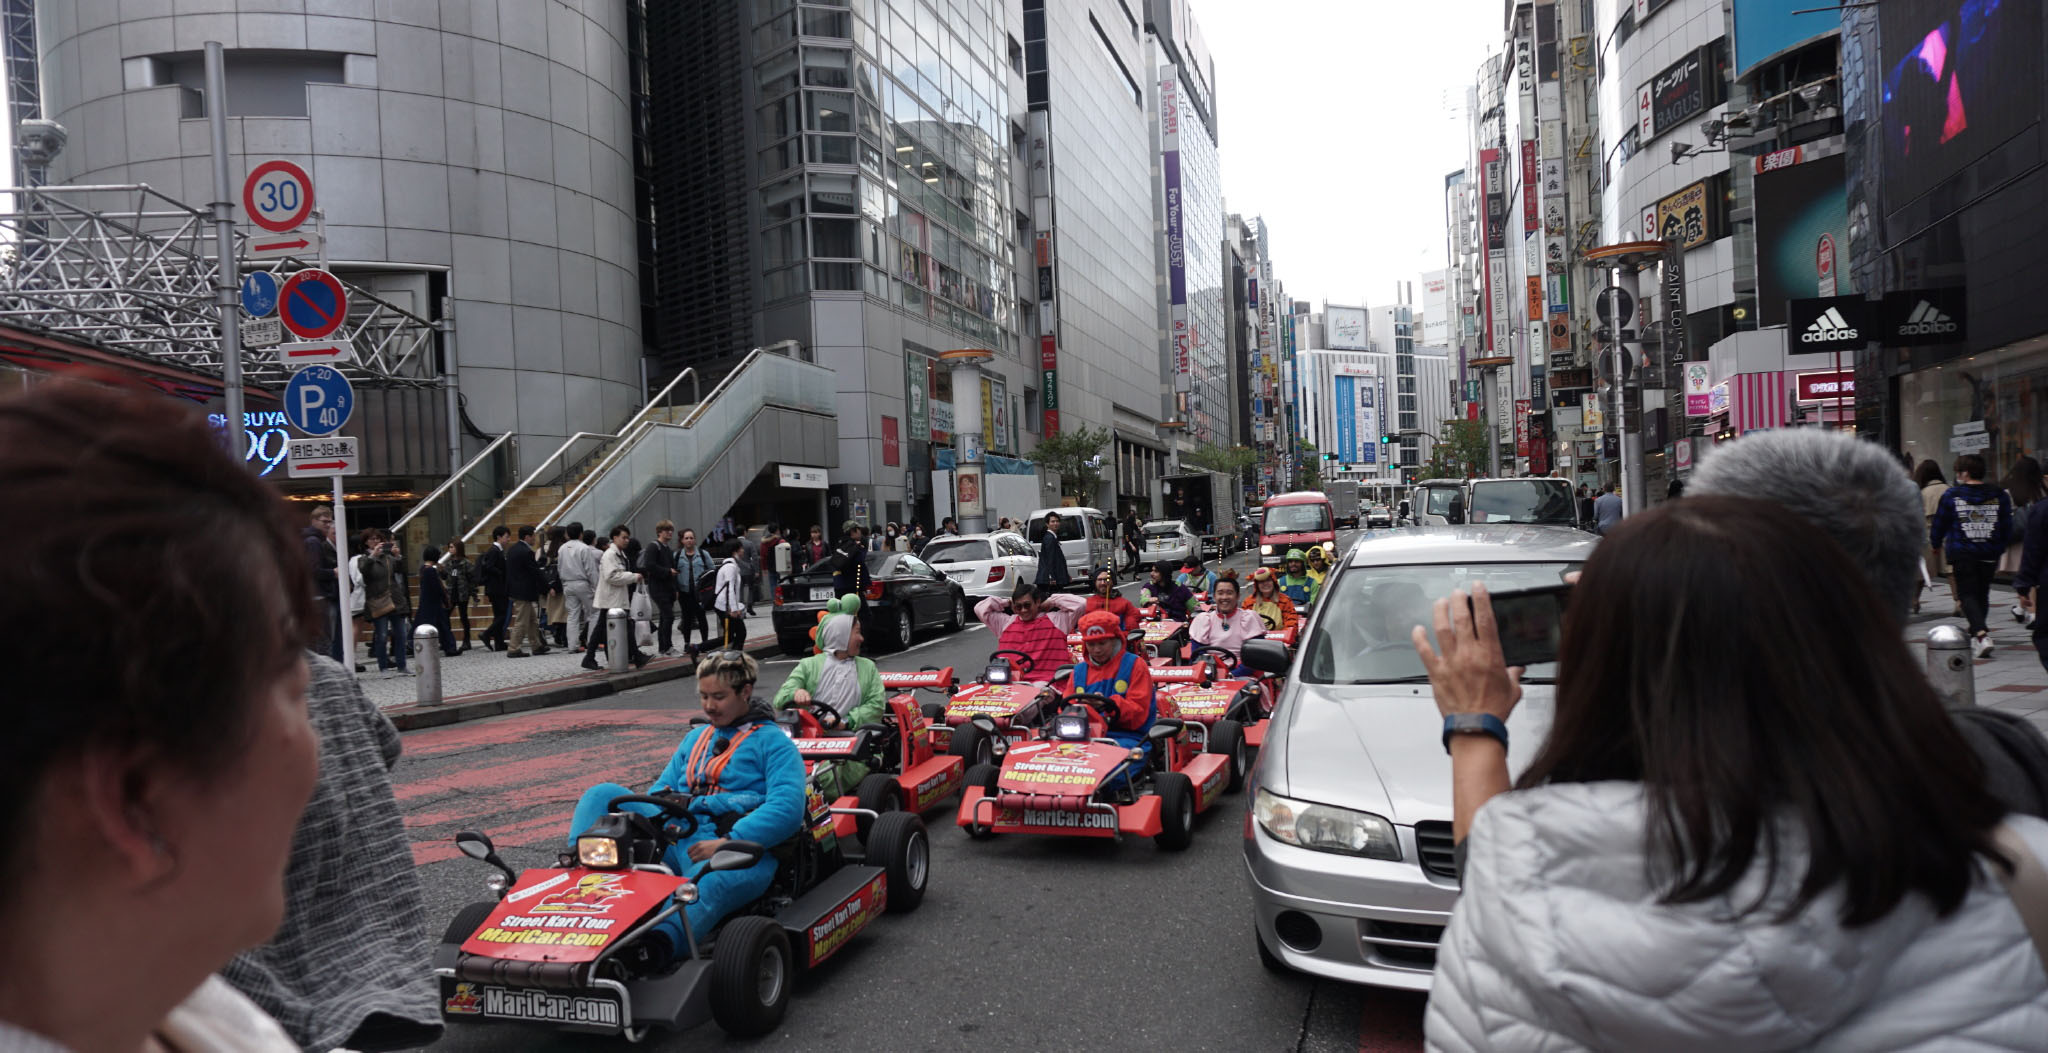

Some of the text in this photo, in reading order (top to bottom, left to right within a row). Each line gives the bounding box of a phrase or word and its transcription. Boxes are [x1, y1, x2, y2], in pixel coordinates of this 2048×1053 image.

[1655, 61, 1698, 98] ダーツバー
[1168, 93, 1177, 134] LABI
[1656, 90, 1701, 130] BAGUS
[260, 180, 298, 212] 30
[1168, 188, 1183, 267] For Your JUST
[1646, 213, 1655, 234] 3
[300, 272, 323, 281] 20-7
[1669, 264, 1681, 304] SAINT
[1493, 276, 1505, 316] SoftBank
[1801, 328, 1858, 343] adidas
[1178, 334, 1188, 373] LABI
[300, 385, 326, 428] P
[207, 412, 288, 427] SHBUYA
[319, 408, 338, 427] 40
[967, 449, 976, 459] 3
[1961, 522, 1995, 530] SEVERE
[1004, 770, 1097, 785] MariCar.com
[1013, 762, 1097, 774] Street Kart Tour
[1023, 808, 1115, 829] MariCar.com
[501, 915, 616, 930] Street Kart Tour
[813, 898, 861, 942] Street Kart Tour
[475, 927, 610, 947] MariCar.com
[486, 989, 618, 1025] MariCar.com
